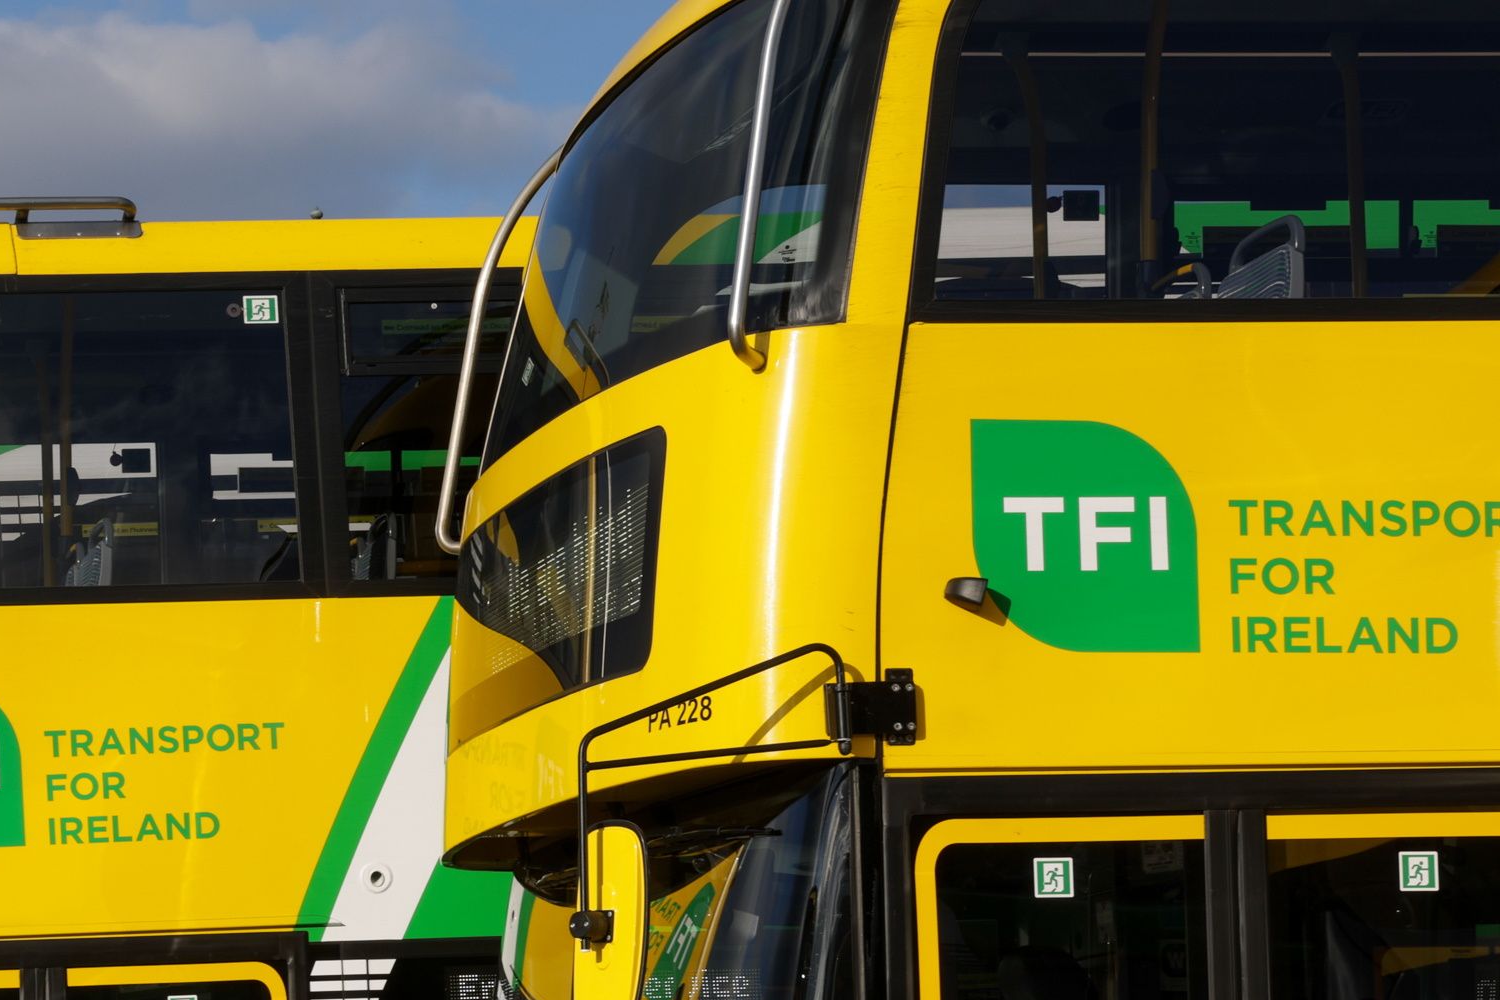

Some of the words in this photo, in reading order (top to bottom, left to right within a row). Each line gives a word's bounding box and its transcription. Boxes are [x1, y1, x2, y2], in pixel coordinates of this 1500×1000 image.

[1002, 496, 1170, 571] TFI
[1229, 558, 1336, 595] FOR
[1231, 616, 1458, 654] IRELAND
[648, 708, 671, 733] PA
[677, 696, 712, 725] 228
[44, 722, 285, 757] TRANSPORT
[46, 772, 126, 801] FOR
[48, 811, 220, 845] IRELAND
